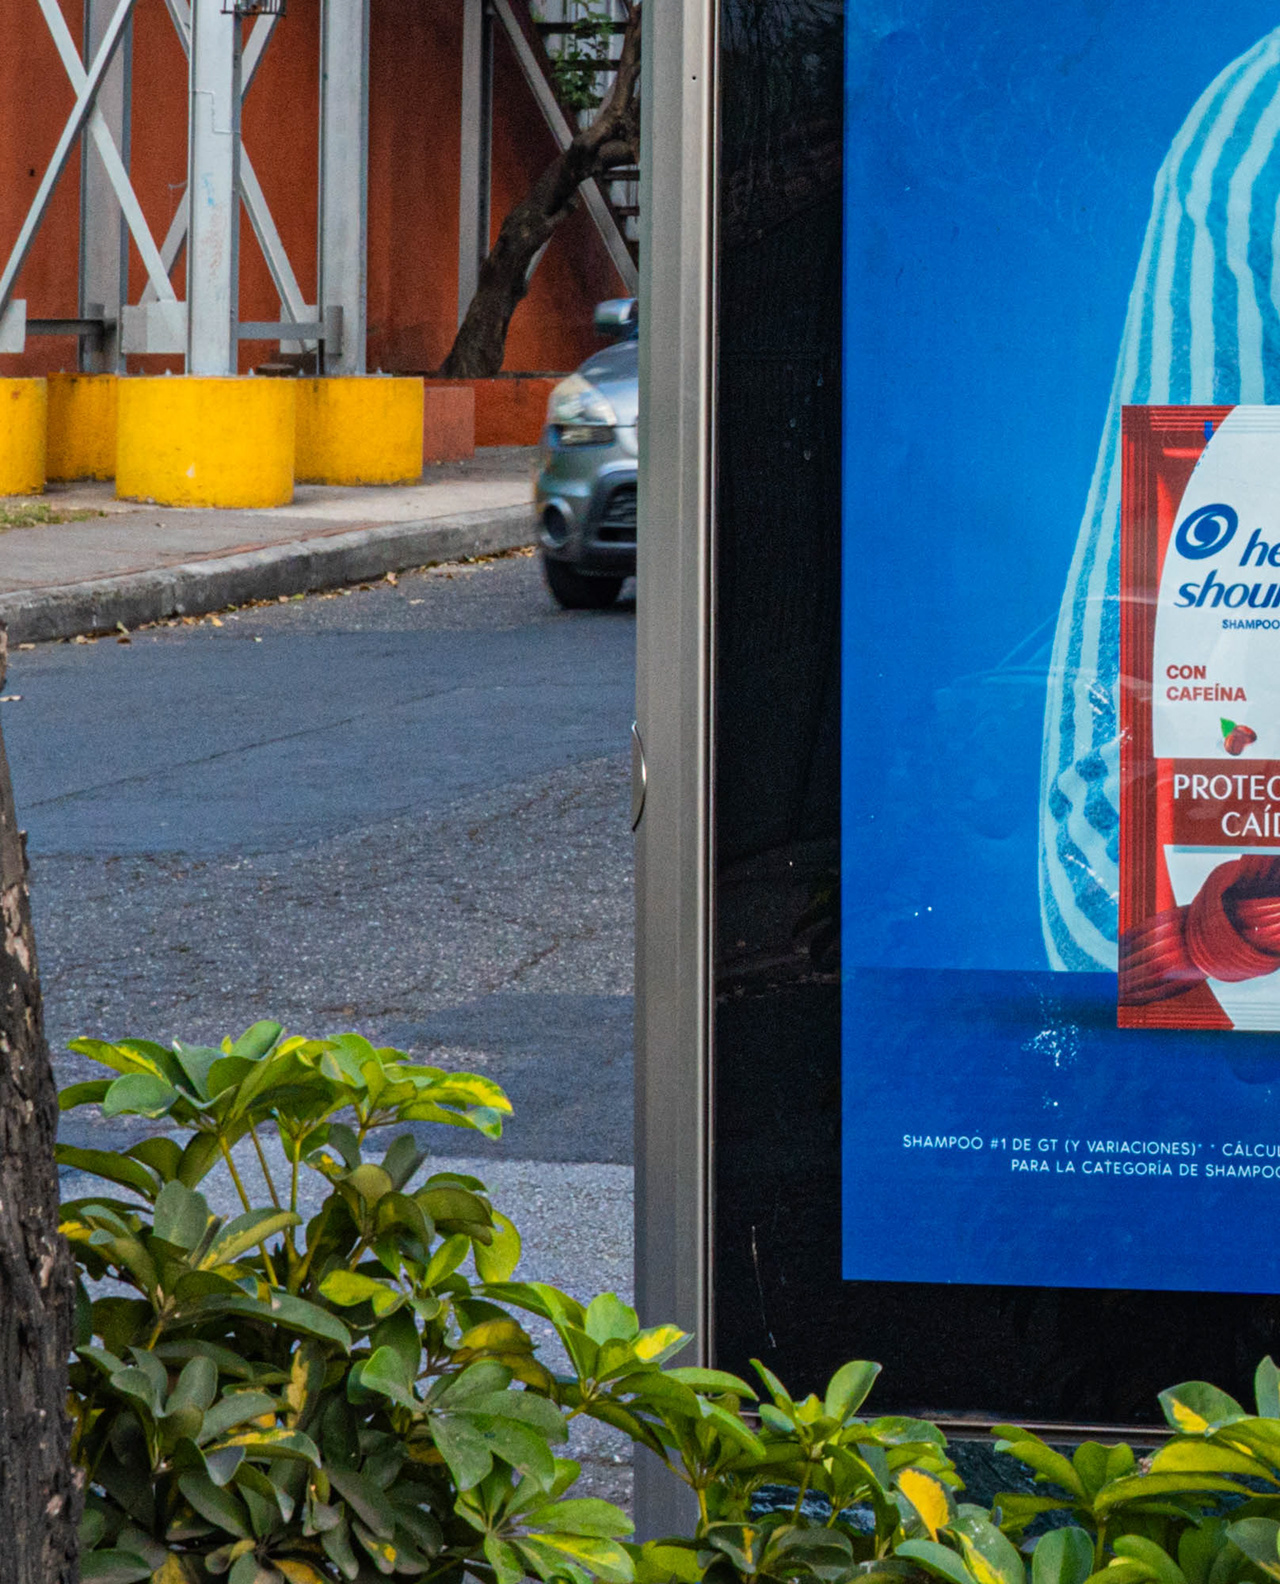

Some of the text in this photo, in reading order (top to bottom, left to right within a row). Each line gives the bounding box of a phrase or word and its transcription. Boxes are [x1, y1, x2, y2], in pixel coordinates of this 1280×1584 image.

[1222, 619, 1280, 630] SHAMPOO
[1166, 665, 1206, 680] CON
[1166, 683, 1247, 701] CAFEÍNA
[903, 1134, 983, 1150] SHAMPOO
[990, 1137, 1007, 1150] #1
[1012, 1138, 1031, 1152] DE
[1038, 1138, 1058, 1152] GT
[1065, 1139, 1080, 1153] (Y
[1011, 1159, 1050, 1172] PARA
[1056, 1160, 1075, 1173] LA
[1081, 1160, 1173, 1176] CATEGORÍA
[1179, 1164, 1198, 1176] DE
